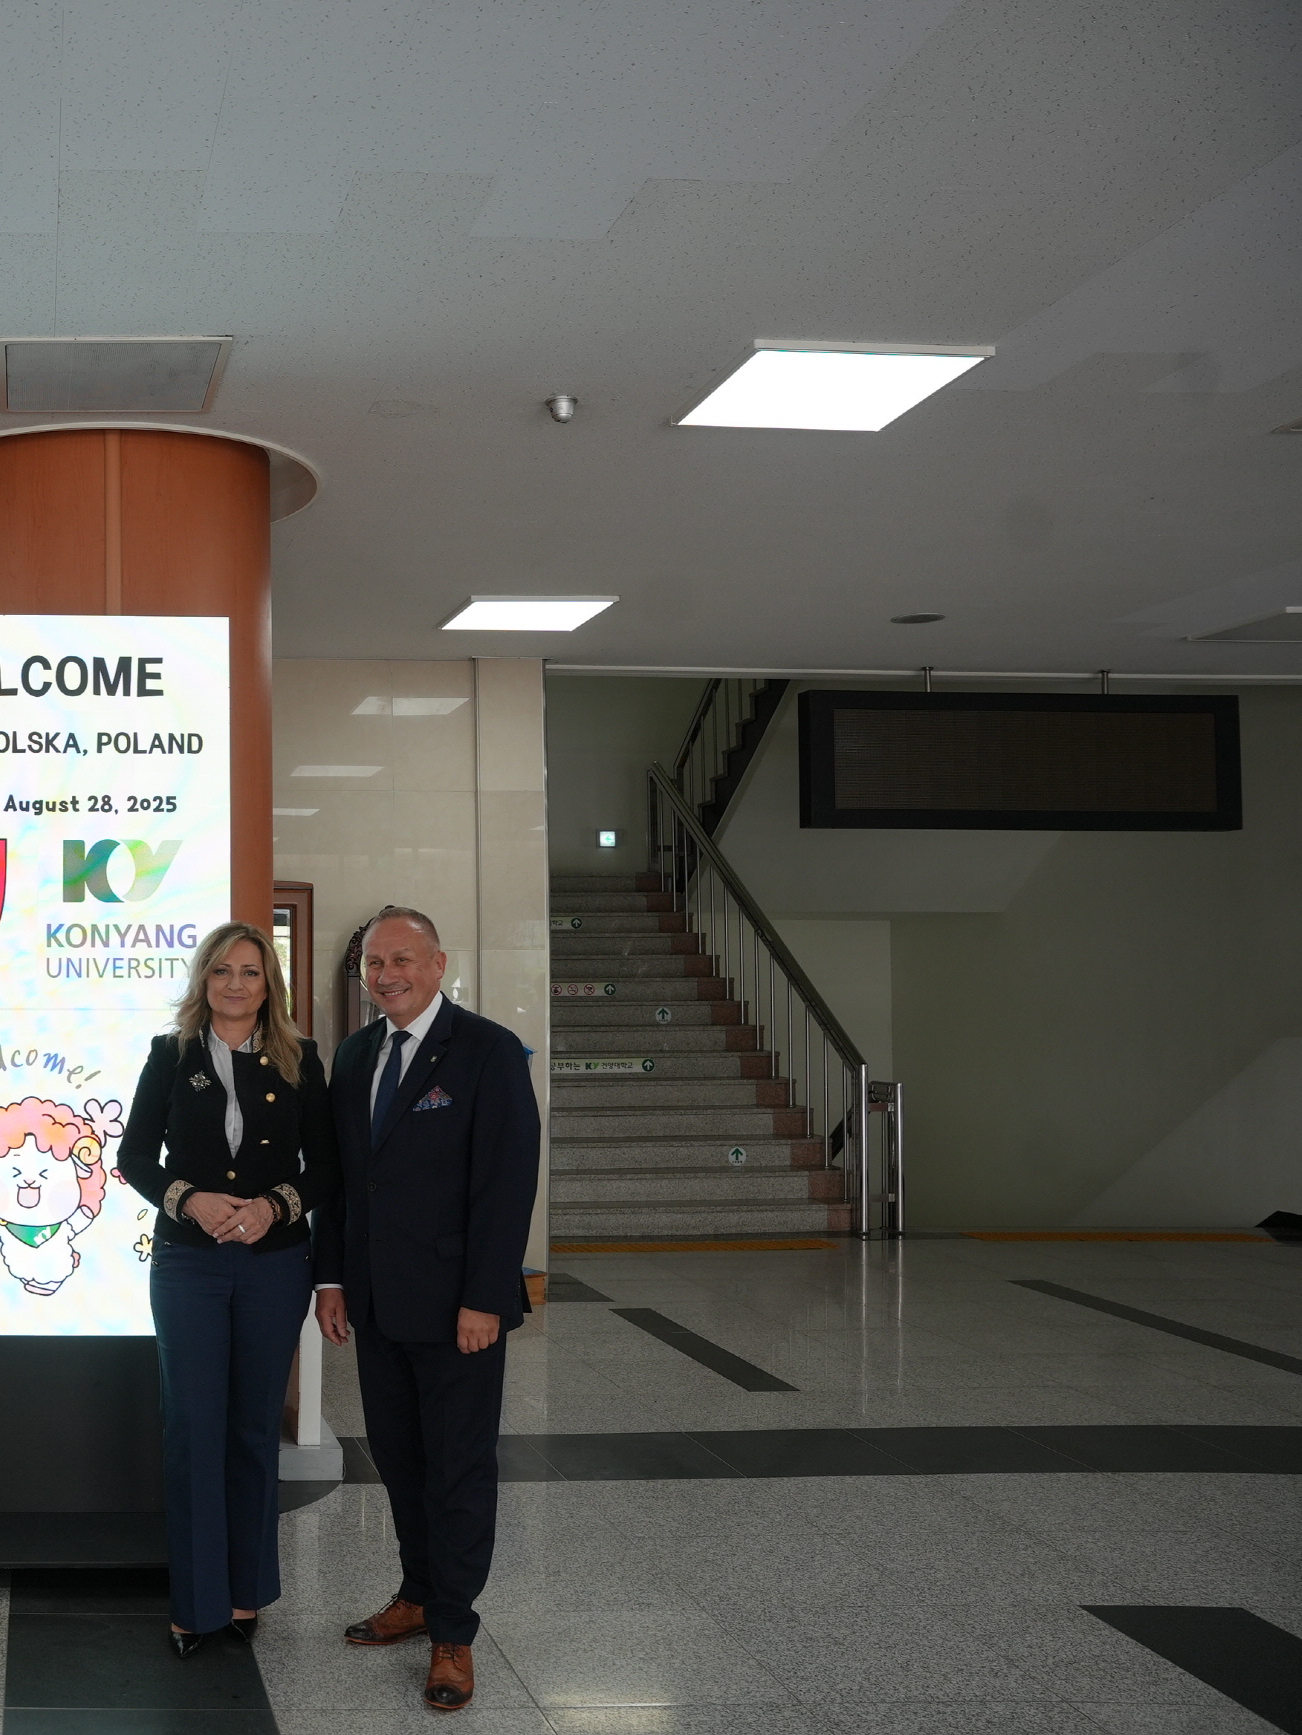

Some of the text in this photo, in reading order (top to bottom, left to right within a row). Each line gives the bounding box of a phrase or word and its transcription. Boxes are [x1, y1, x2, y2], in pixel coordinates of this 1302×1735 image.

[95, 731, 204, 755] POLAND
[3, 795, 80, 816] August
[87, 795, 119, 815] 28,
[126, 795, 178, 813] 2025
[46, 923, 198, 949] KONYANG
